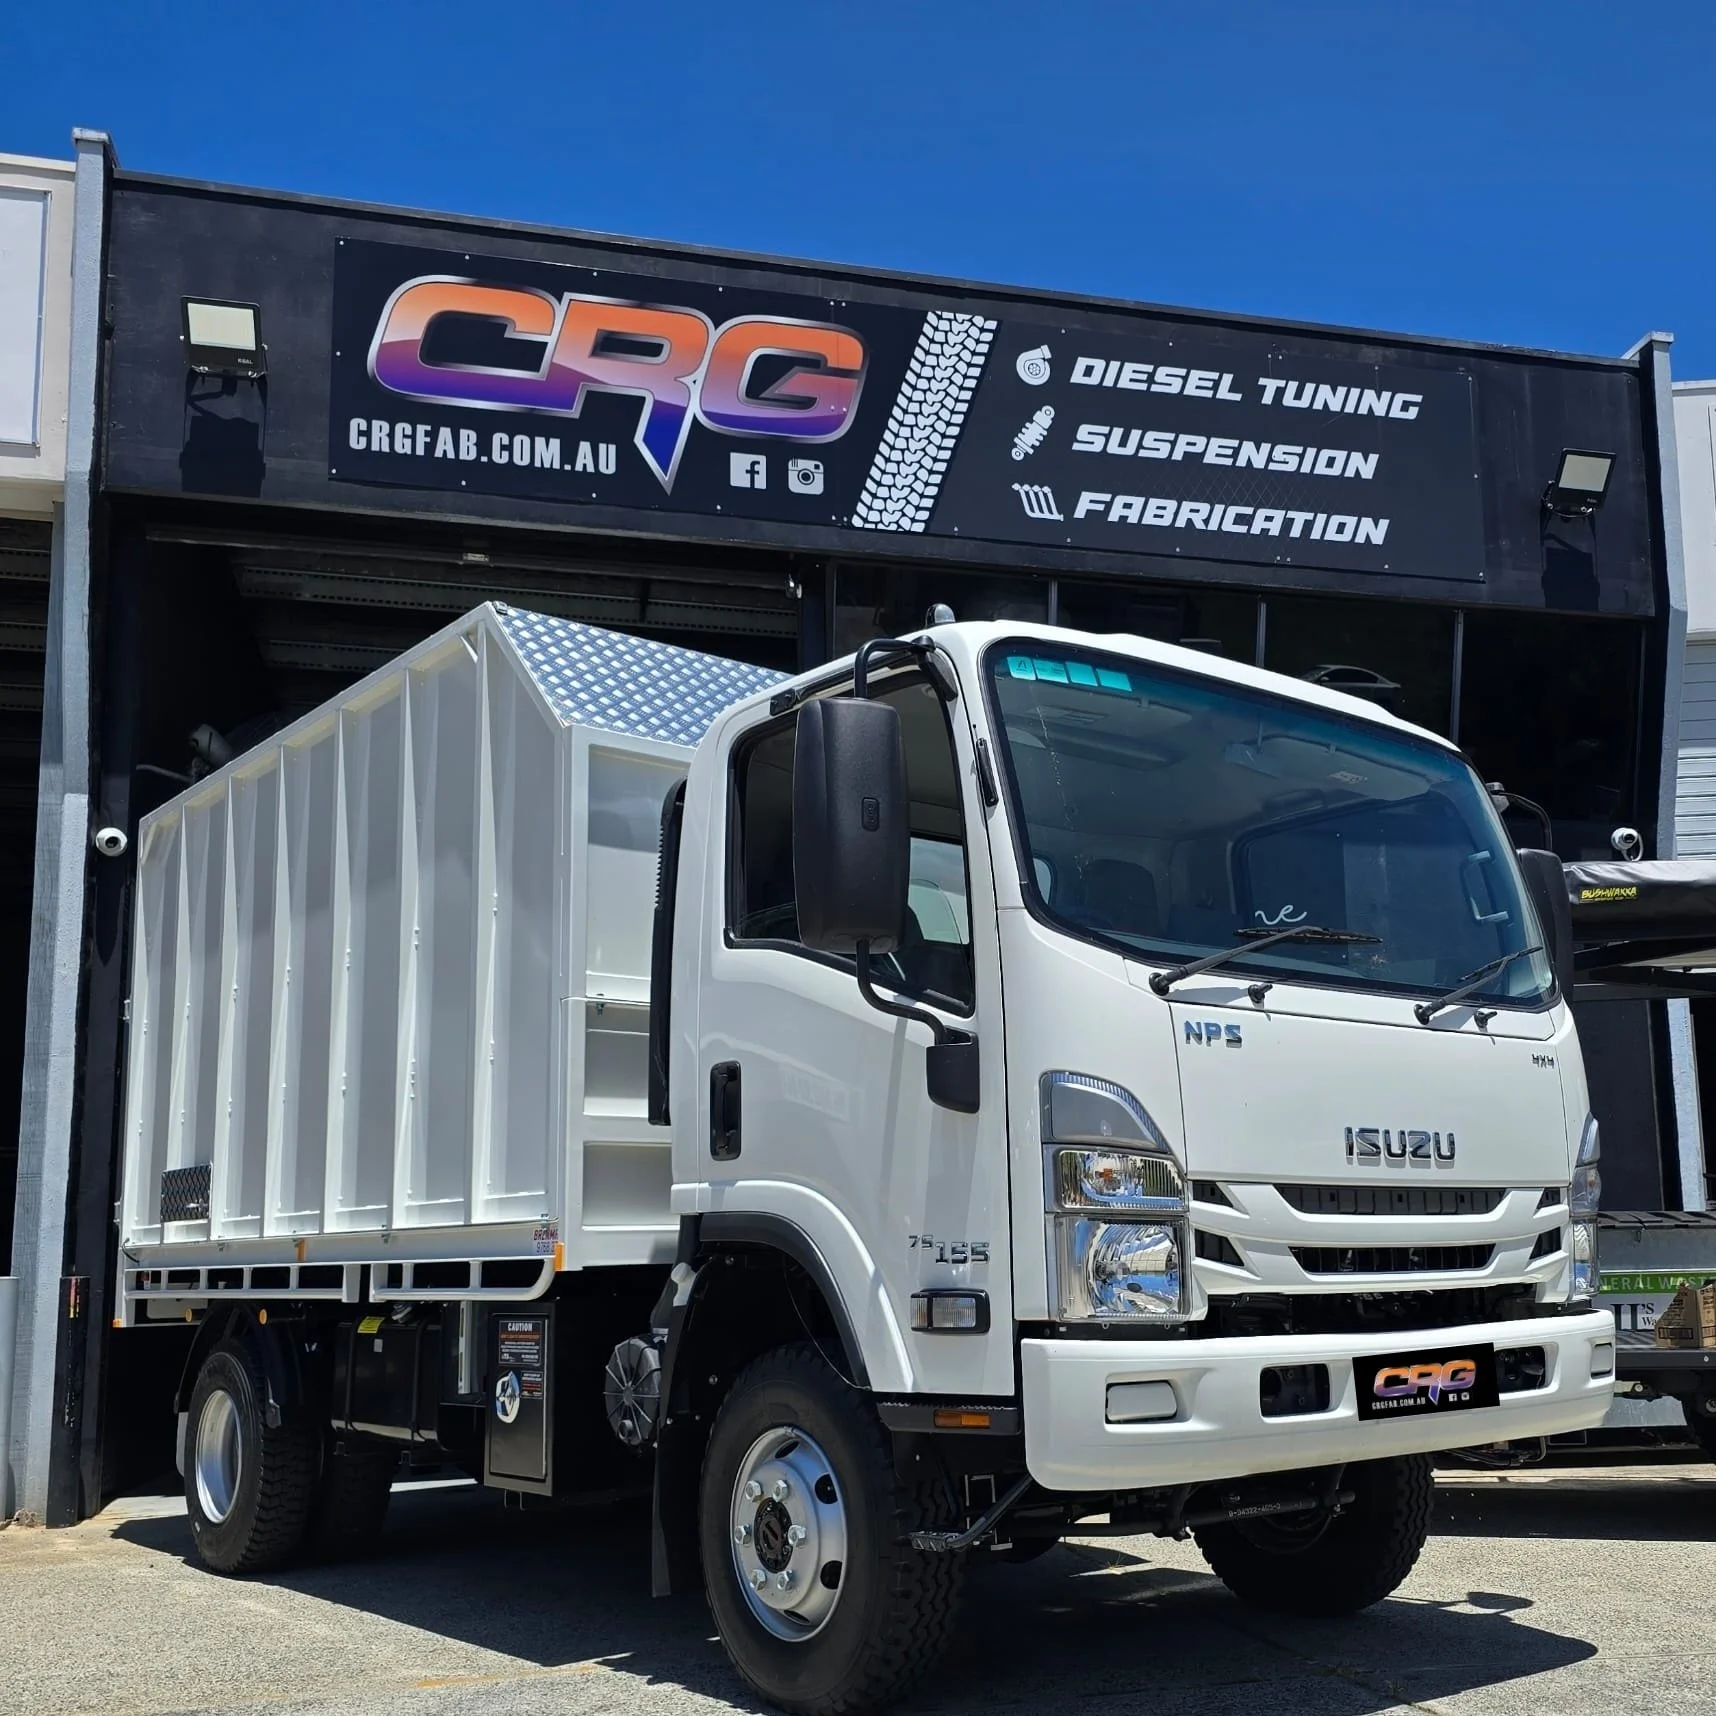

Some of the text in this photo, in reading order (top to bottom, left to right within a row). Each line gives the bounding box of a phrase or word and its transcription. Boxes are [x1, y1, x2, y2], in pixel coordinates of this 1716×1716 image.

[367, 274, 869, 495] CRG
[1069, 356, 1423, 420] DIESEL TUNING
[348, 417, 617, 475] CRGFAB.COM.AU
[1071, 424, 1380, 479] SUSPENSION
[1073, 491, 1389, 545] FABRICATION
[1581, 886, 1638, 899] BUSHWAKKA
[1184, 1020, 1243, 1048] NPS
[1344, 1126, 1456, 1162] ISUZU
[908, 1234, 990, 1265] 75 155
[507, 1322, 533, 1332] CAUTION
[1374, 1359, 1477, 1406] CRG
